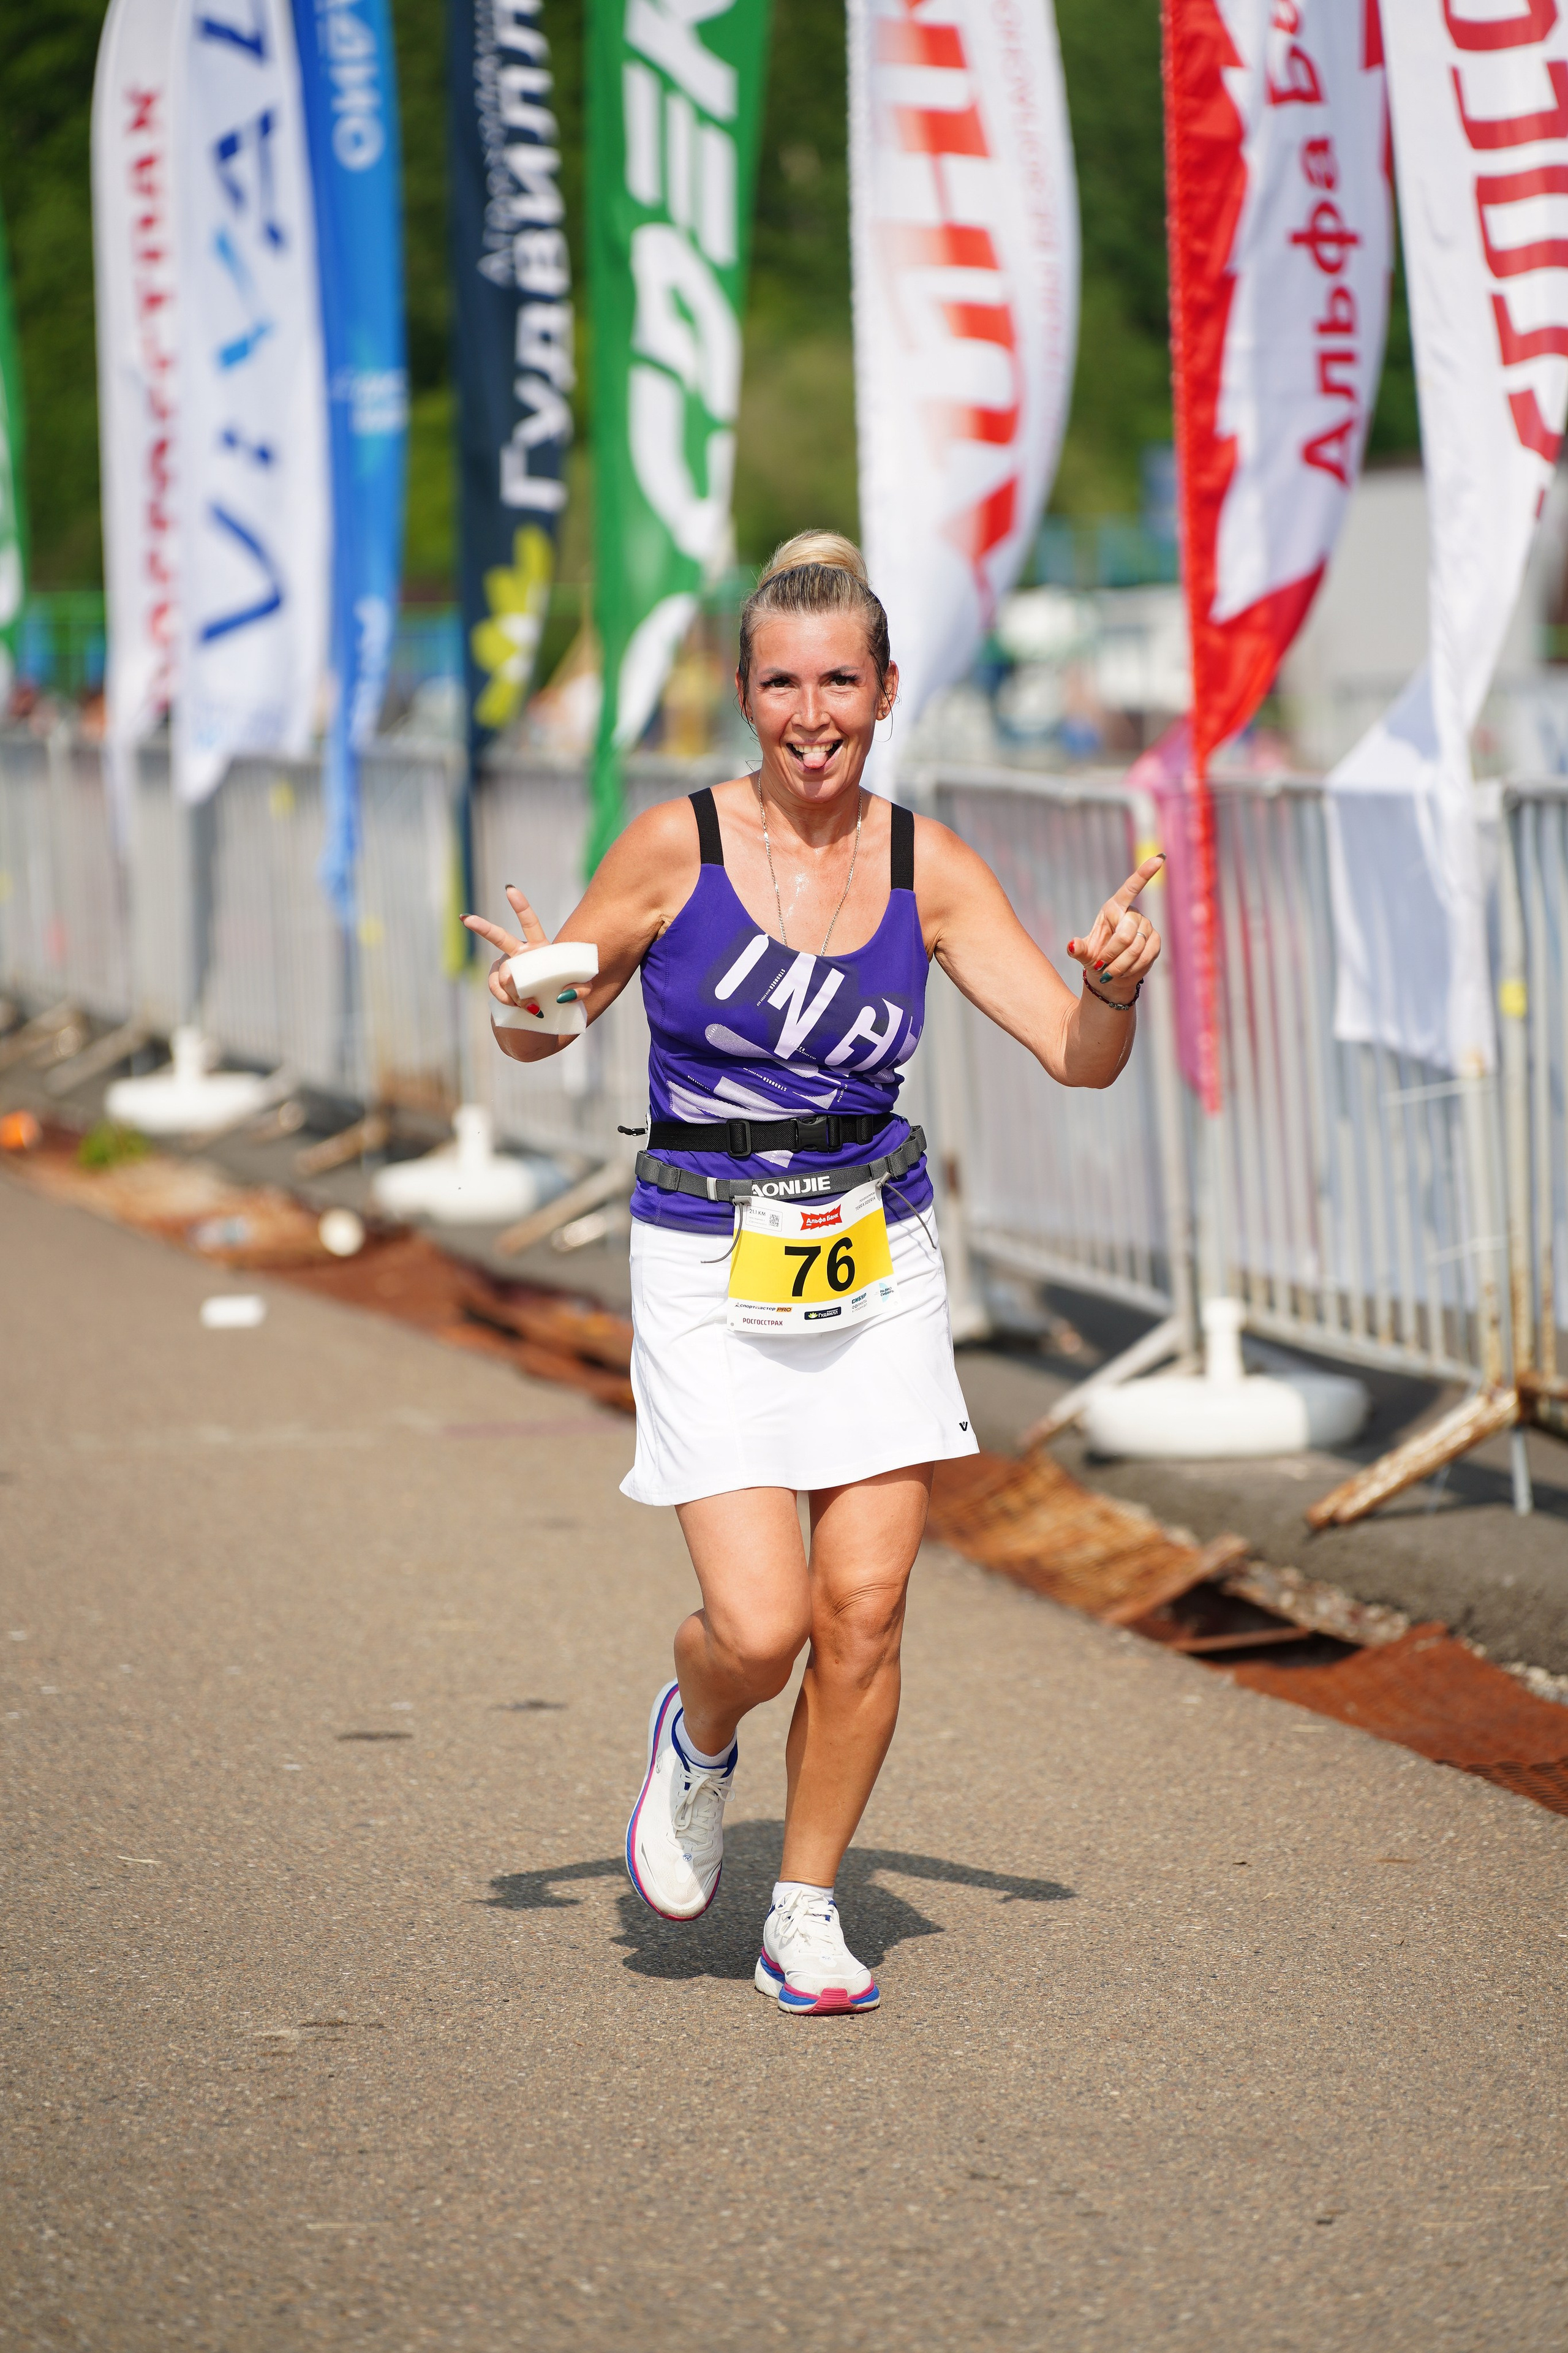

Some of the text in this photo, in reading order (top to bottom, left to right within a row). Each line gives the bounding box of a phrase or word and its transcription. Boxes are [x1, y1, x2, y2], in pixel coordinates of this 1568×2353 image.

[1289, 135, 1362, 488] Альфа
[763, 1076, 787, 1092] STRONGER
[752, 1176, 831, 1197] AONIJIE
[806, 1213, 839, 1226] Альфа Банк
[784, 1236, 856, 1297] 76
[851, 1293, 867, 1304] СИБУР
[742, 1318, 783, 1326] РОСГОССТРАХ
